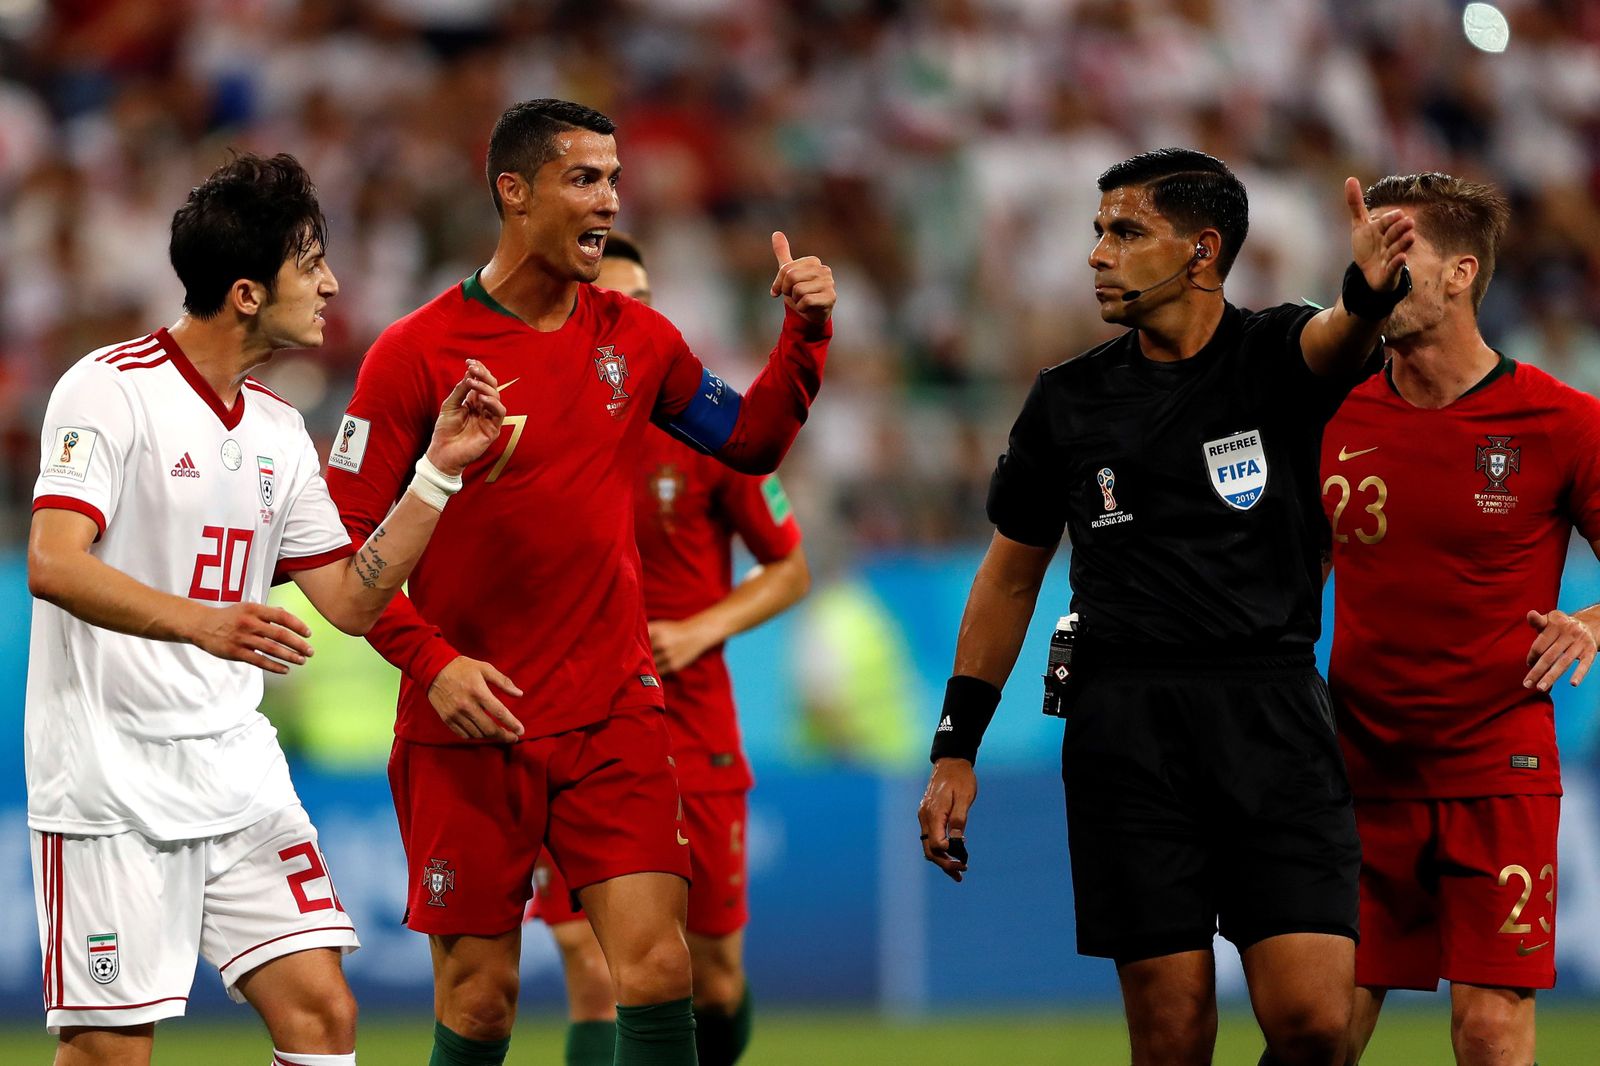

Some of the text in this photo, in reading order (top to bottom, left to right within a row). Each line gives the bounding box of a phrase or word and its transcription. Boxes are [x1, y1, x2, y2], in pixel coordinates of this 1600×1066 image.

[485, 415, 528, 483] 7
[1208, 436, 1258, 456] REFEREE
[170, 467, 201, 479] adidas
[1217, 459, 1261, 484] FIFA
[1091, 513, 1134, 529] RUSSIA 2018
[1235, 492, 1256, 505] 2018
[1322, 474, 1388, 545] 23
[188, 525, 255, 603] 20
[278, 841, 345, 914] 2
[1498, 863, 1554, 934] 23
